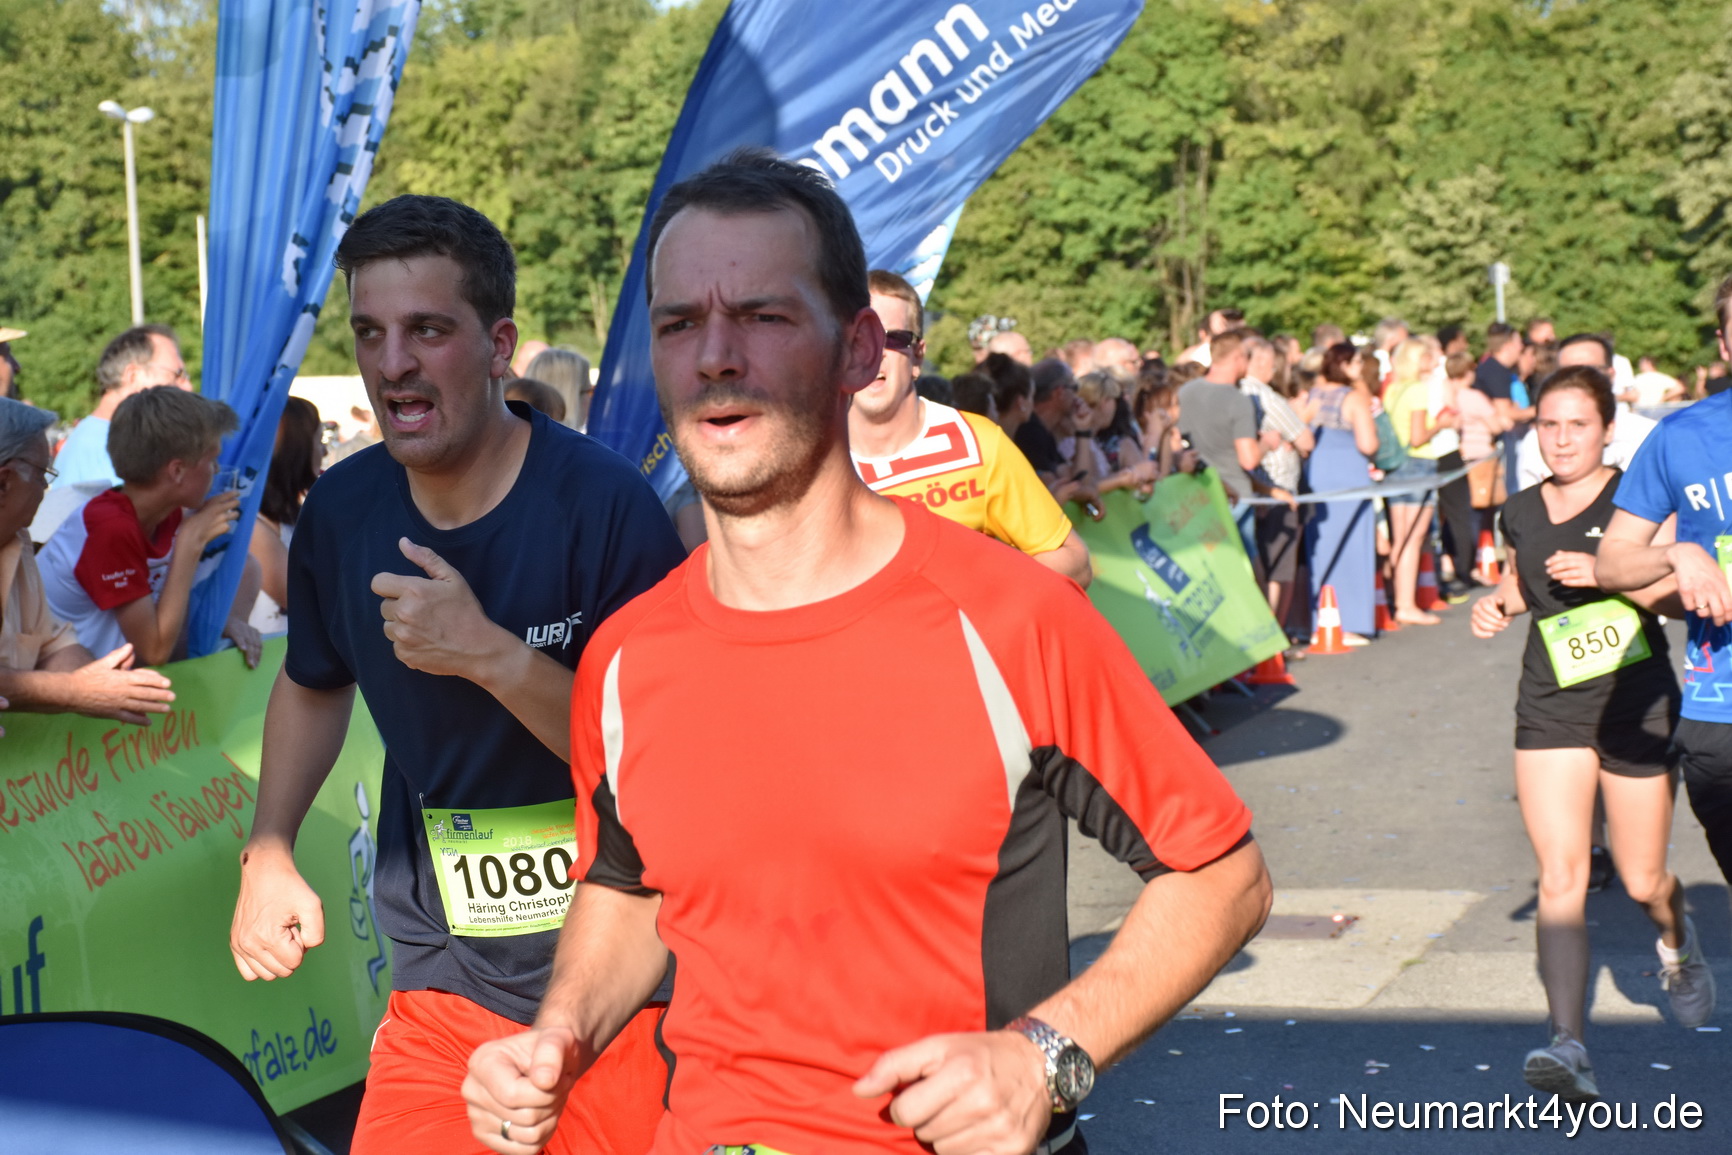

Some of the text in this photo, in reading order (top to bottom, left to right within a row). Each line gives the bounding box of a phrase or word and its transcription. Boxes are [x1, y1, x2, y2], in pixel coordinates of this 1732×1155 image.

[798, 3, 990, 182] mann
[874, 100, 959, 184] Druck
[955, 40, 1014, 104] und
[640, 432, 673, 475] isch
[1568, 625, 1620, 660] 850
[102, 708, 199, 783] Firmen
[62, 811, 173, 892] laufen
[446, 829, 494, 840] firmenlauf
[503, 836, 533, 848] 2018
[453, 847, 575, 900] 1080
[468, 892, 573, 915] Häring Christoph
[469, 915, 514, 923] Lebenshilfe
[516, 908, 559, 921] Neumarkt
